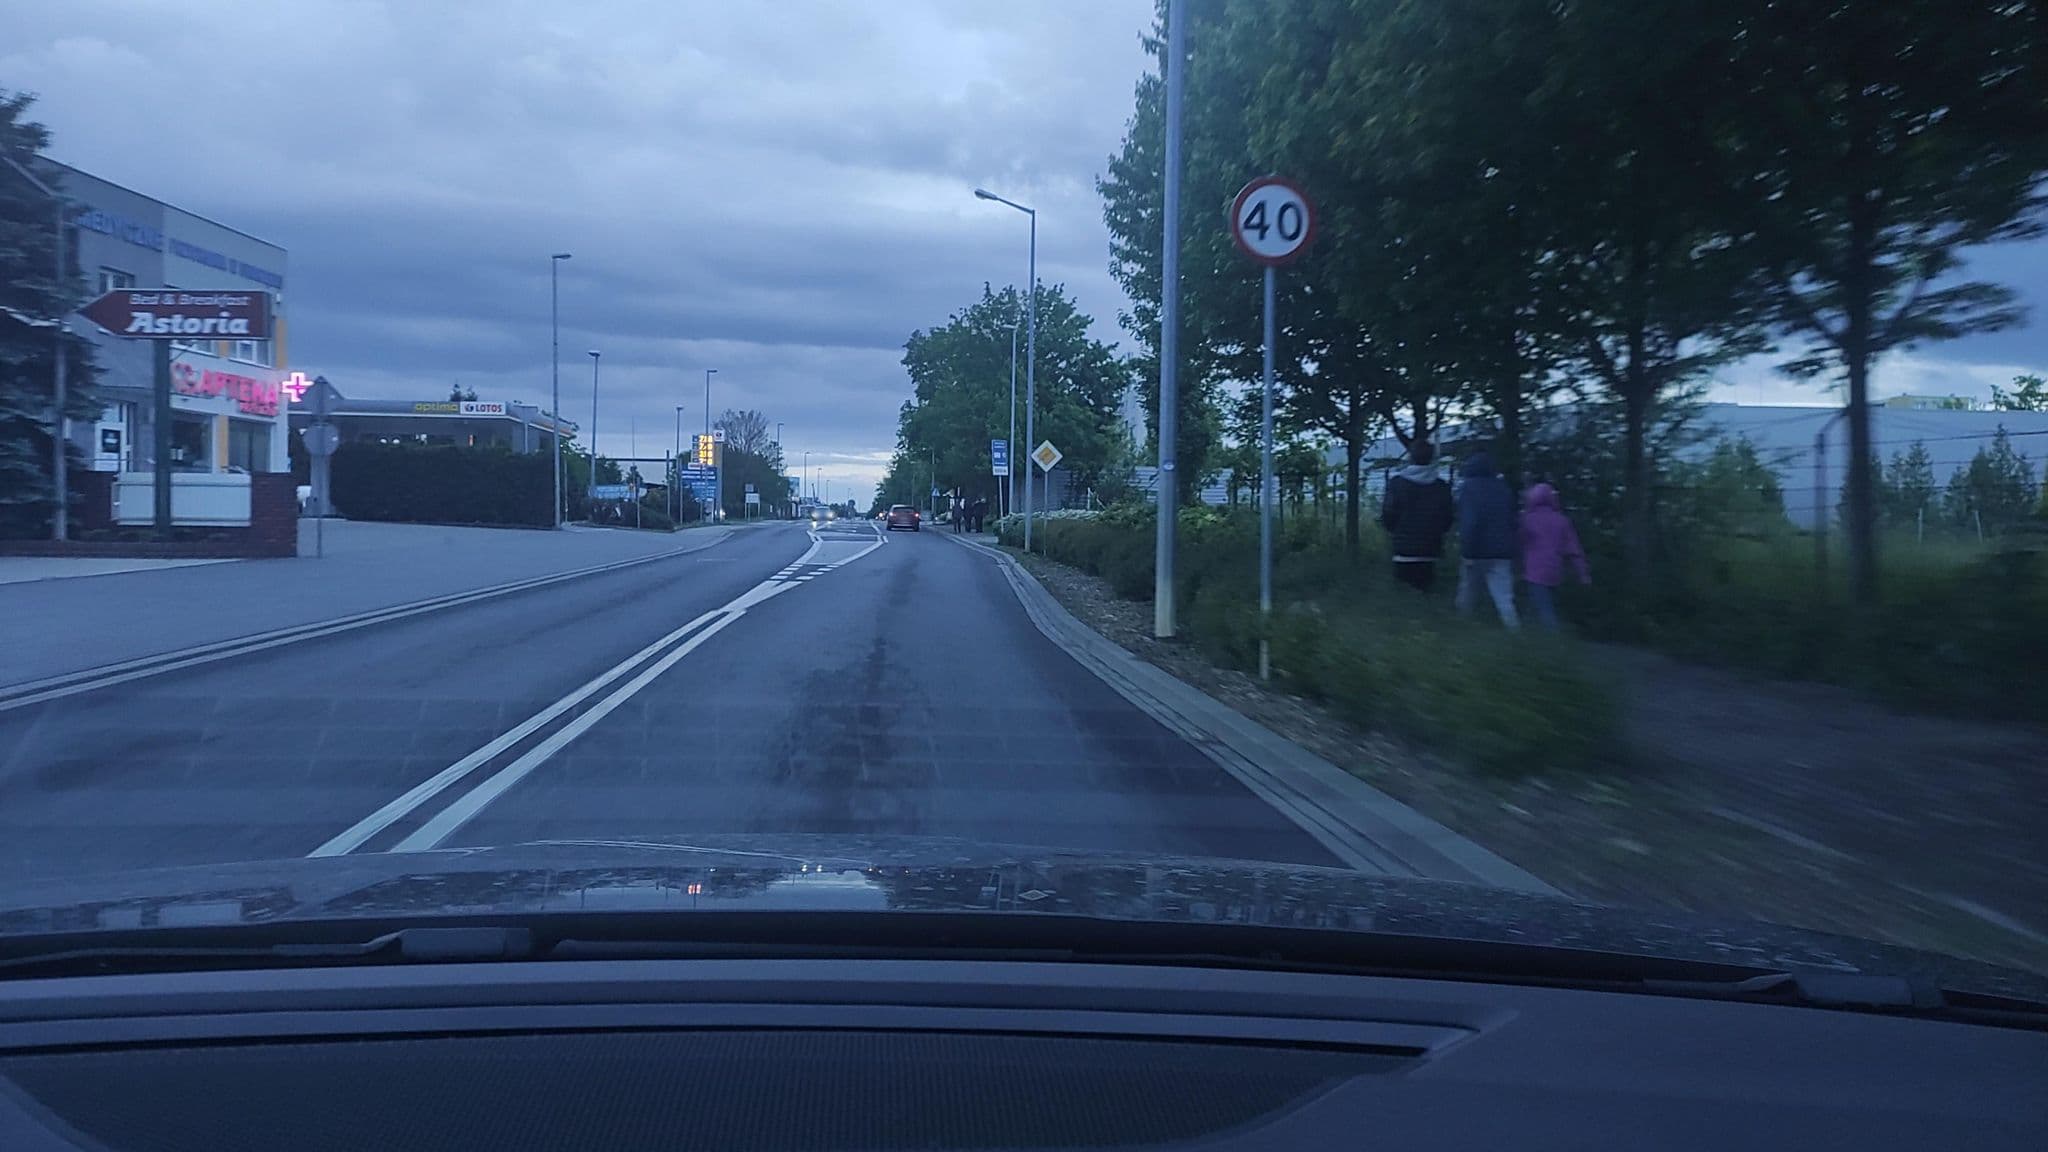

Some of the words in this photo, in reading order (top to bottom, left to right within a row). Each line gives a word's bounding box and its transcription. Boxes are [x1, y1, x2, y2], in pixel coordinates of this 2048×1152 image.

[1243, 200, 1302, 241] 40
[129, 293, 158, 305] Bed
[162, 294, 176, 305] &
[178, 294, 249, 308] Breakfast
[125, 311, 249, 334] Astoria
[202, 369, 279, 404] APTEKA
[415, 402, 458, 412] optima
[475, 404, 502, 413] LOTOS
